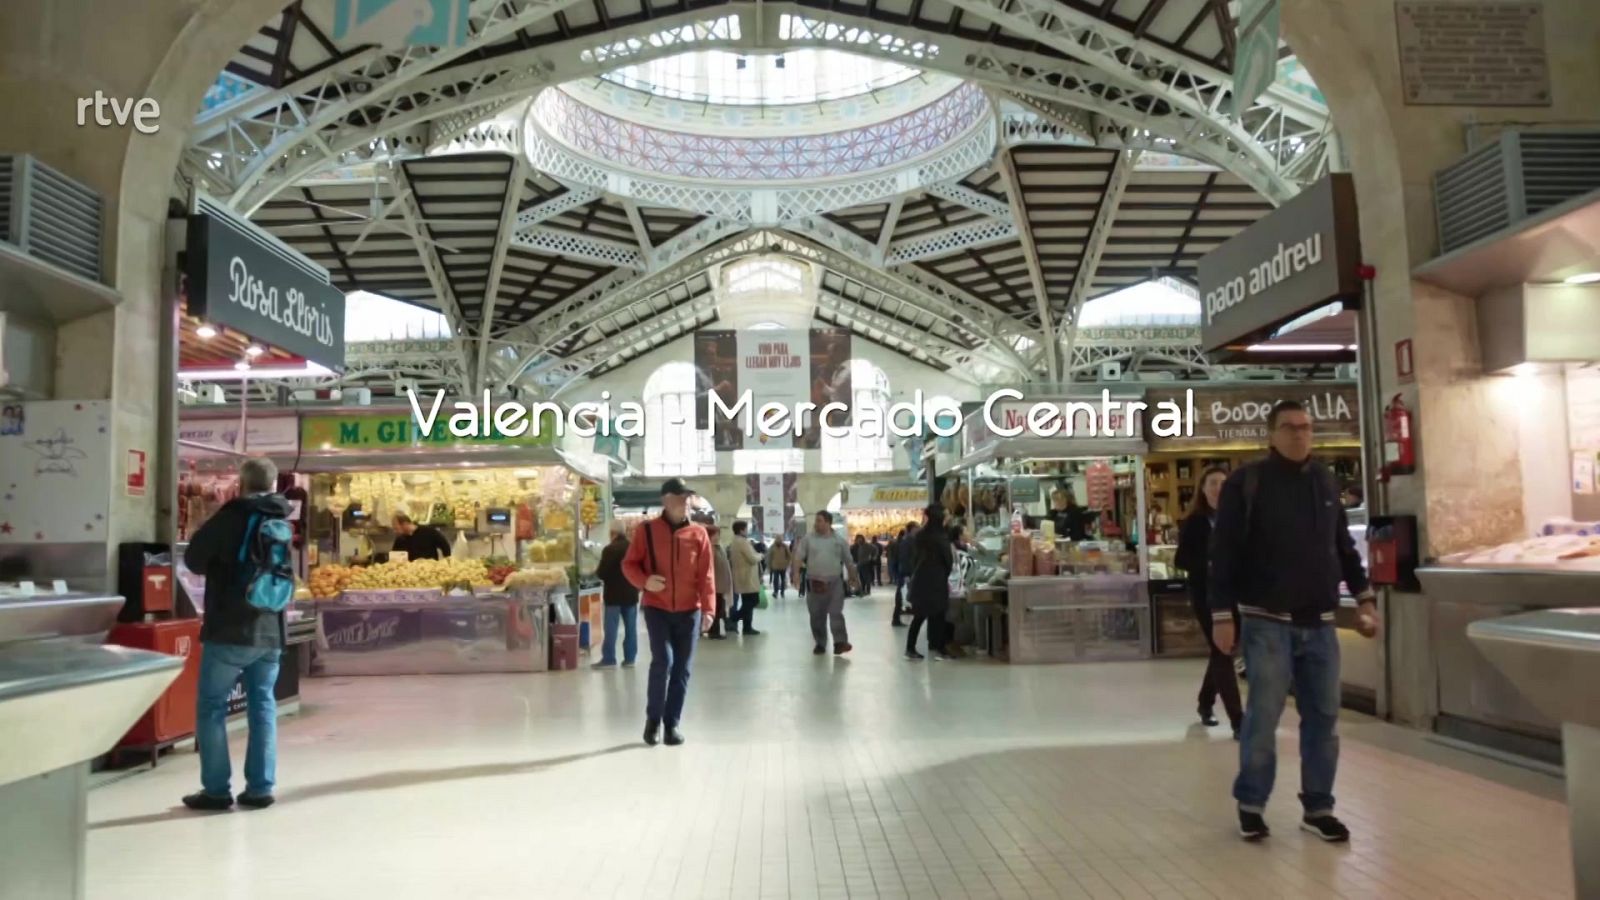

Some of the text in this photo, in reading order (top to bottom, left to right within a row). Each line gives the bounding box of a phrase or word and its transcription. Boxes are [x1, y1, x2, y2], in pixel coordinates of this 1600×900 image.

[1206, 233, 1322, 326] paco andreu
[228, 256, 334, 348] Rosa Lloris
[1211, 392, 1352, 425] BoDeiLLA
[339, 421, 368, 445] M.
[1217, 428, 1257, 440] TIENDA
